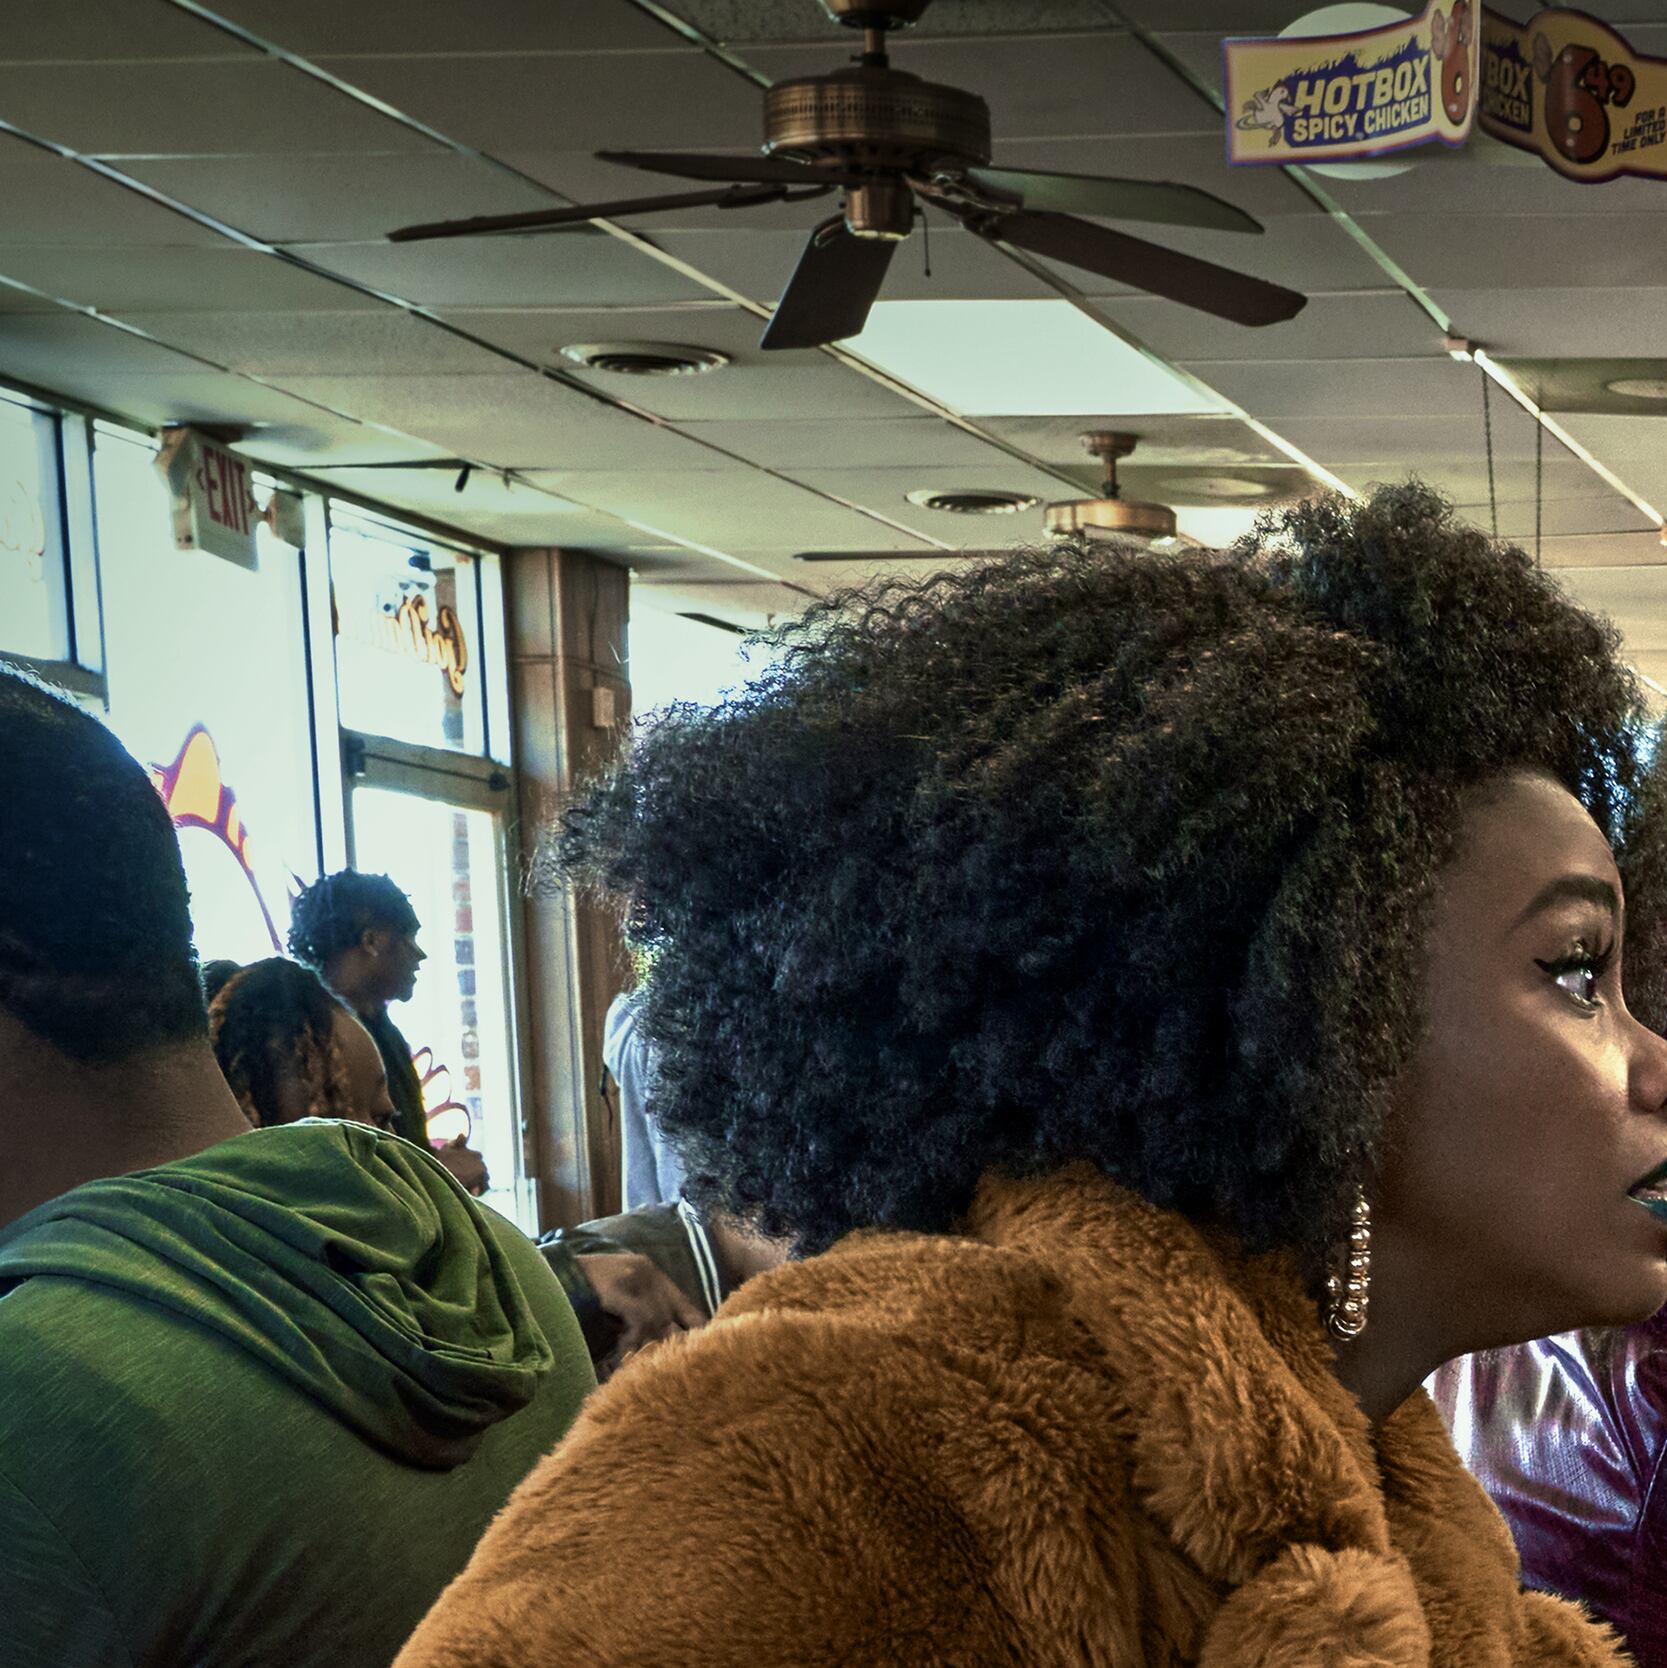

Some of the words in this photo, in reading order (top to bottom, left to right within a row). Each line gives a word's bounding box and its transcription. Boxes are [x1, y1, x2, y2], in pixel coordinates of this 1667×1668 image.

[1294, 54, 1429, 116] HOTBOX
[1487, 51, 1530, 101] BOX
[1292, 114, 1359, 142] SPICY
[1364, 94, 1429, 134] CHICKEN
[1624, 119, 1666, 138] LIMITED
[1635, 110, 1655, 123] FOR
[1659, 106, 1666, 118] A
[1612, 140, 1636, 155] TIME
[1640, 132, 1666, 149] ONLY
[203, 445, 249, 536] EXIT
